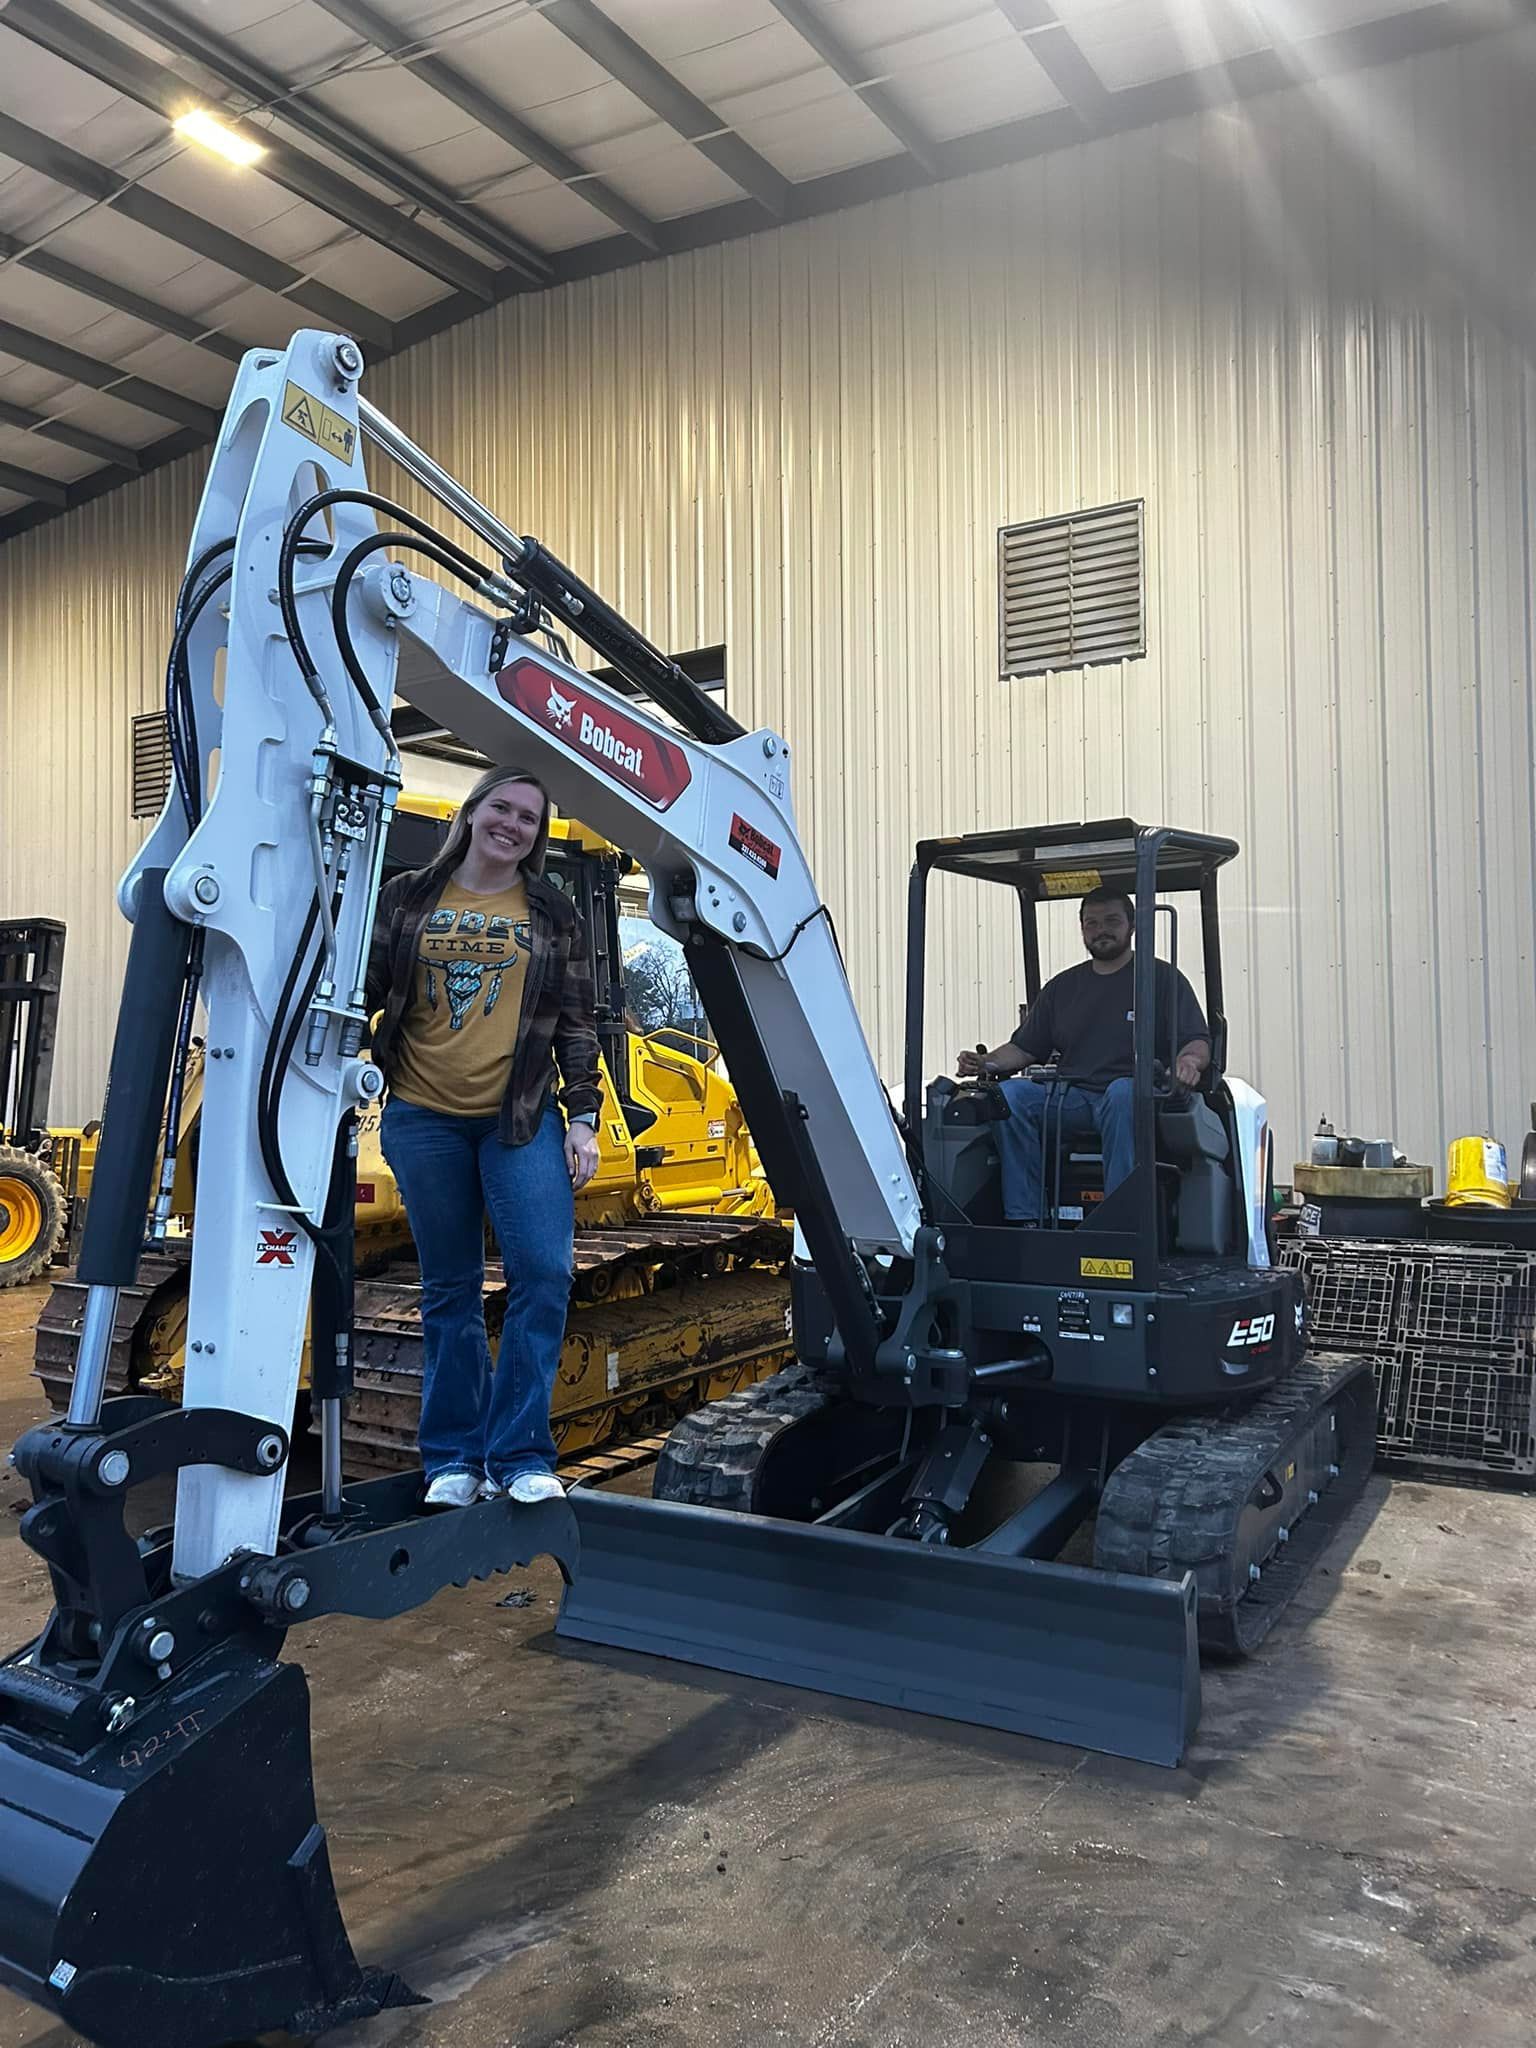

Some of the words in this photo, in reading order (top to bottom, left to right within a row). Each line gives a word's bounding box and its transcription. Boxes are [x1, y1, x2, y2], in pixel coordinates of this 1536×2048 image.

[580, 711, 643, 778] Bobcat
[424, 909, 532, 952] ODEO
[426, 939, 505, 955] TIME
[257, 1244, 297, 1252] X-CHANGE
[1226, 1313, 1276, 1347] E50
